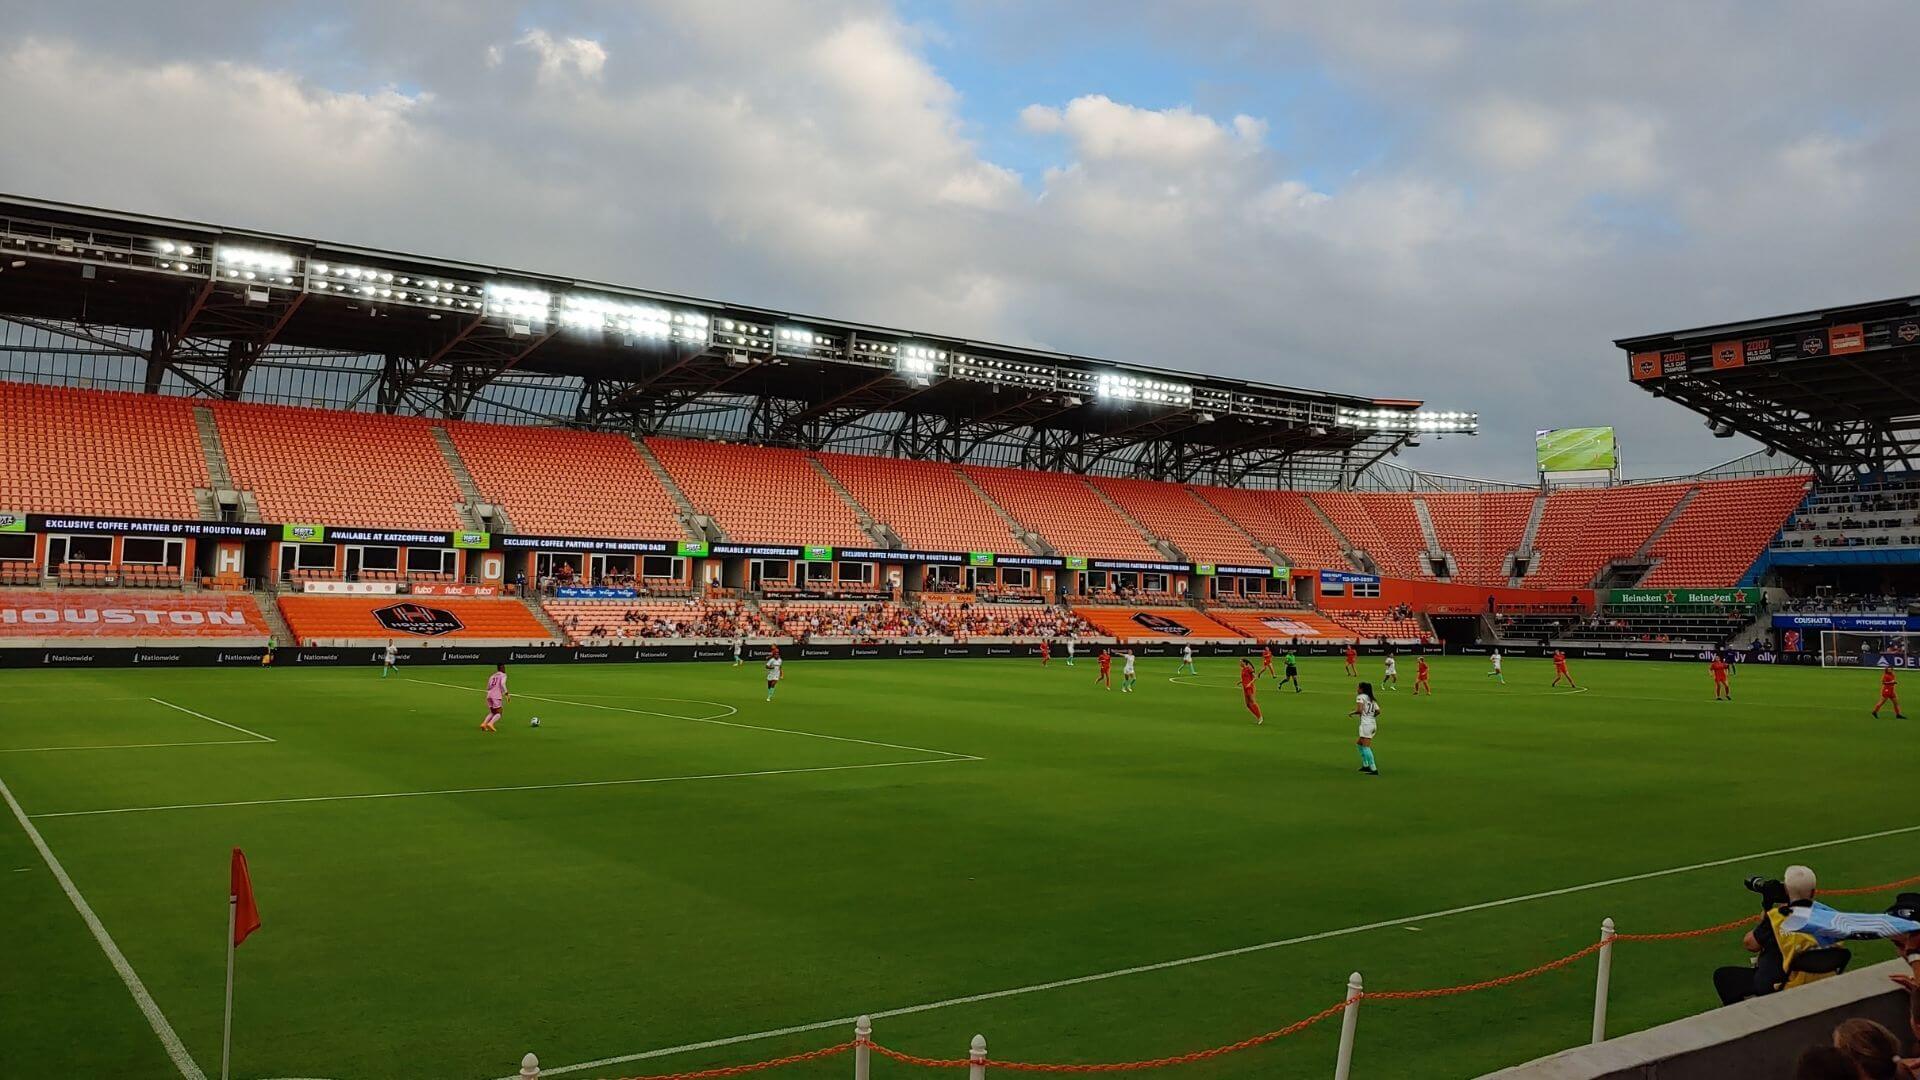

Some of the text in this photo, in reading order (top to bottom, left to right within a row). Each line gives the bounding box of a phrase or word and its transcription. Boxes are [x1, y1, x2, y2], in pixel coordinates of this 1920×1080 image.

[46, 519, 267, 536] EXCLUSIVE COFFEE PARTNER OF THE HOUSTON DASH
[331, 531, 446, 544] AVAILABLE AT KATZCOFFEE.COM
[504, 538, 539, 547] EXCLUSIVE
[541, 540, 564, 548] COFFEE
[566, 541, 594, 549] PARTNER
[596, 541, 604, 549] OF
[606, 542, 617, 550] THE
[618, 543, 648, 551] HOUSTON
[714, 546, 743, 554] AVAILABLE
[220, 549, 241, 572] H
[484, 559, 501, 579] O
[1043, 575, 1054, 591] T
[1622, 594, 1662, 602] Heineken
[1688, 593, 1731, 602] Heineken
[1699, 650, 1717, 661] ally
[1757, 650, 1776, 661] ally
[1894, 657, 1920, 666] DE
